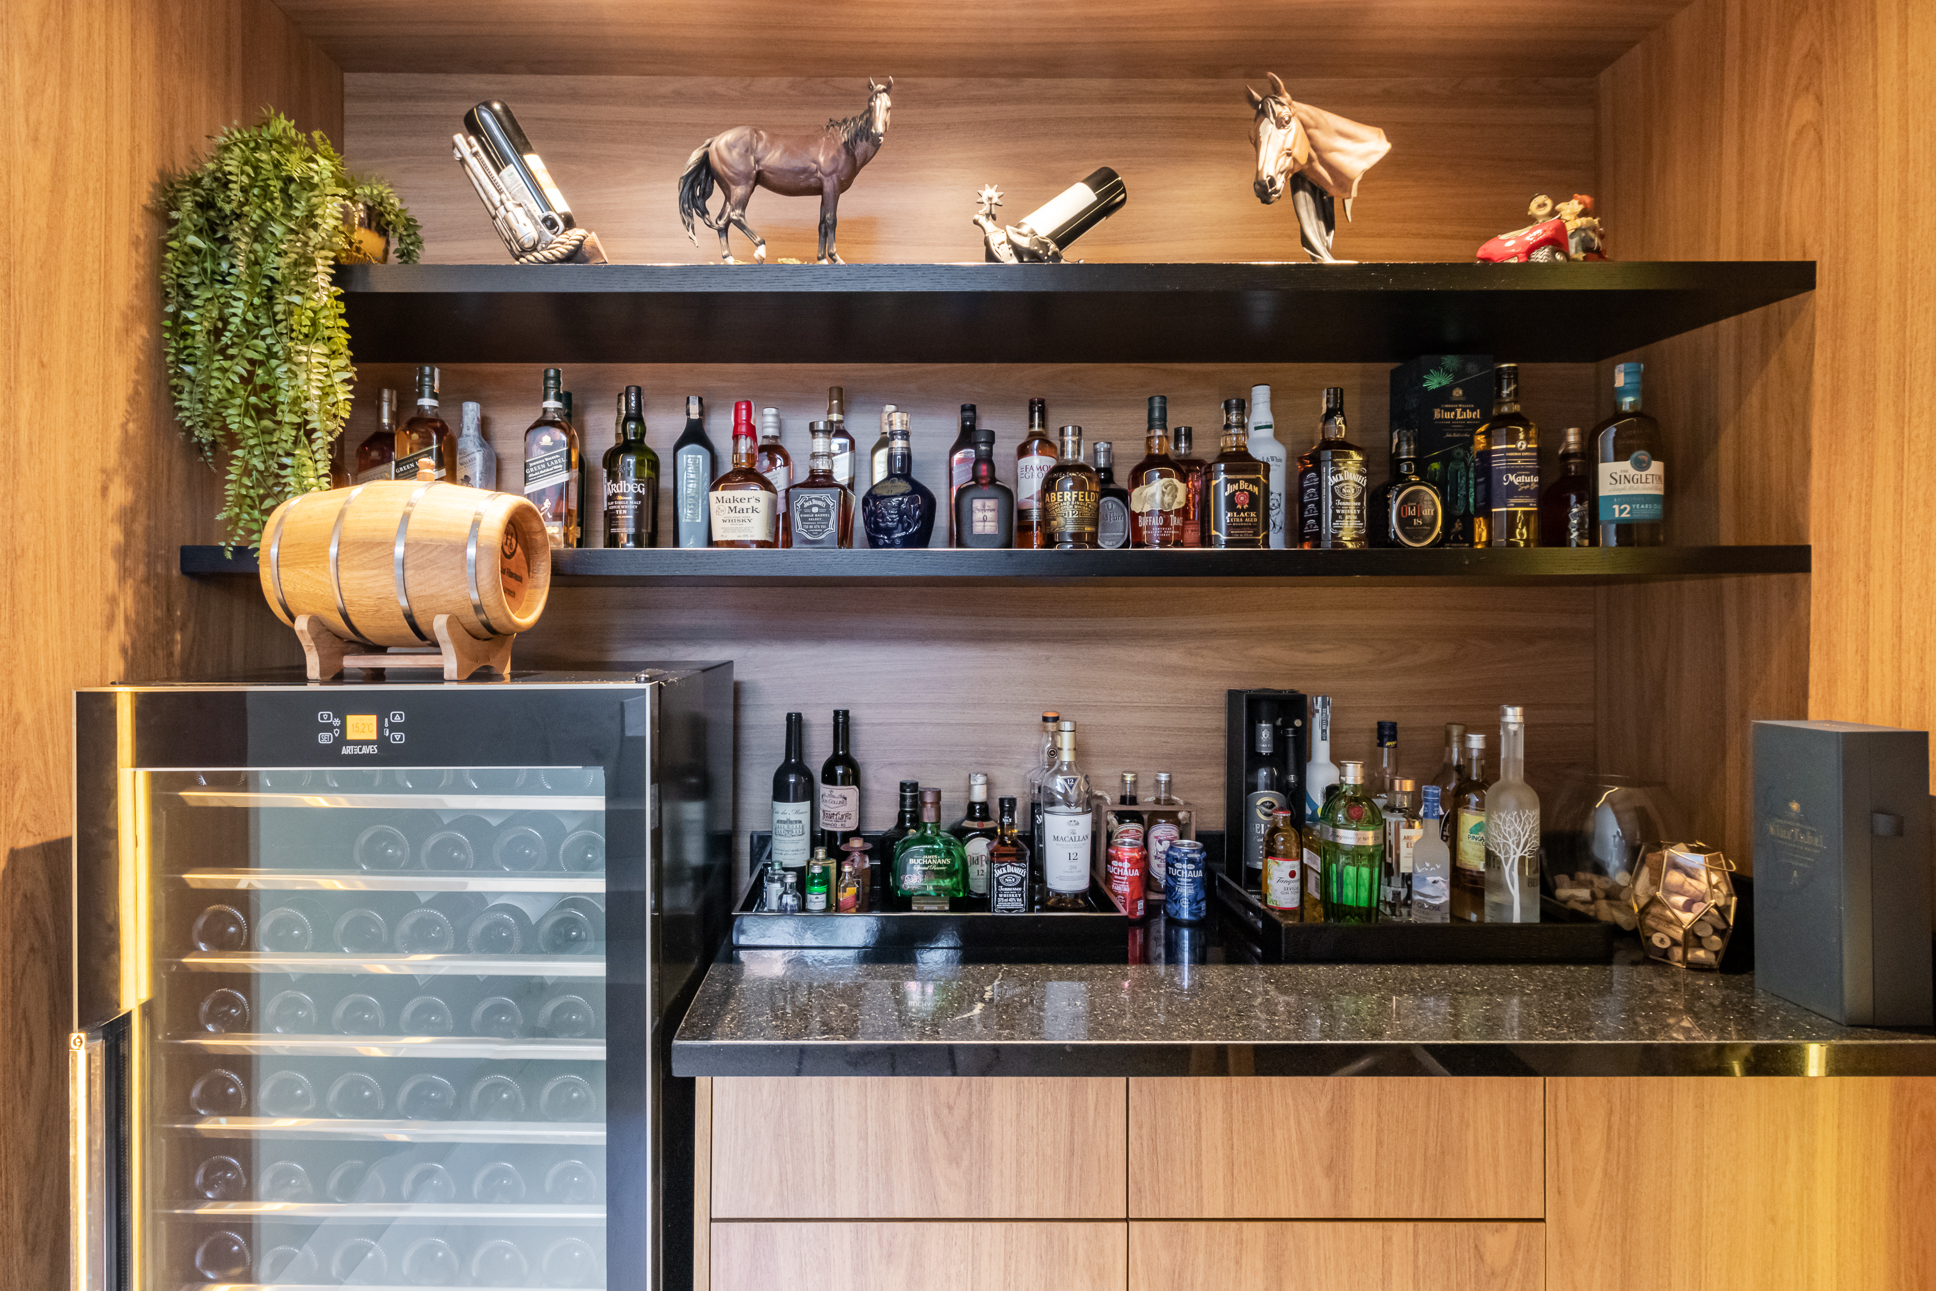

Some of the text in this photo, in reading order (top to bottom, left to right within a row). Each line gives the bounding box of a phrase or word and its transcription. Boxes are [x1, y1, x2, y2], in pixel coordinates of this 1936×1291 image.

[1433, 408, 1480, 420] Blue Label
[395, 462, 415, 474] GREEN
[526, 458, 565, 474] GREEN LABEL
[1024, 464, 1051, 472] FAMO
[1328, 472, 1344, 486] JACK
[1503, 474, 1539, 485] Matuta
[1224, 480, 1258, 496] JIM BEAM
[715, 496, 761, 504] Maker's
[1045, 491, 1100, 503] ABERFELDY
[728, 506, 762, 514] Mark
[1400, 504, 1434, 518] Old Parr
[1612, 504, 1631, 518] 12
[1138, 514, 1184, 527] BUFFALO TRACE
[1052, 834, 1090, 842] MACALLAN
[1068, 852, 1078, 860] 12
[994, 866, 1007, 877] JACK
[1107, 864, 1139, 876] TUCHAUA
[1168, 866, 1203, 877] TUCHAUA
